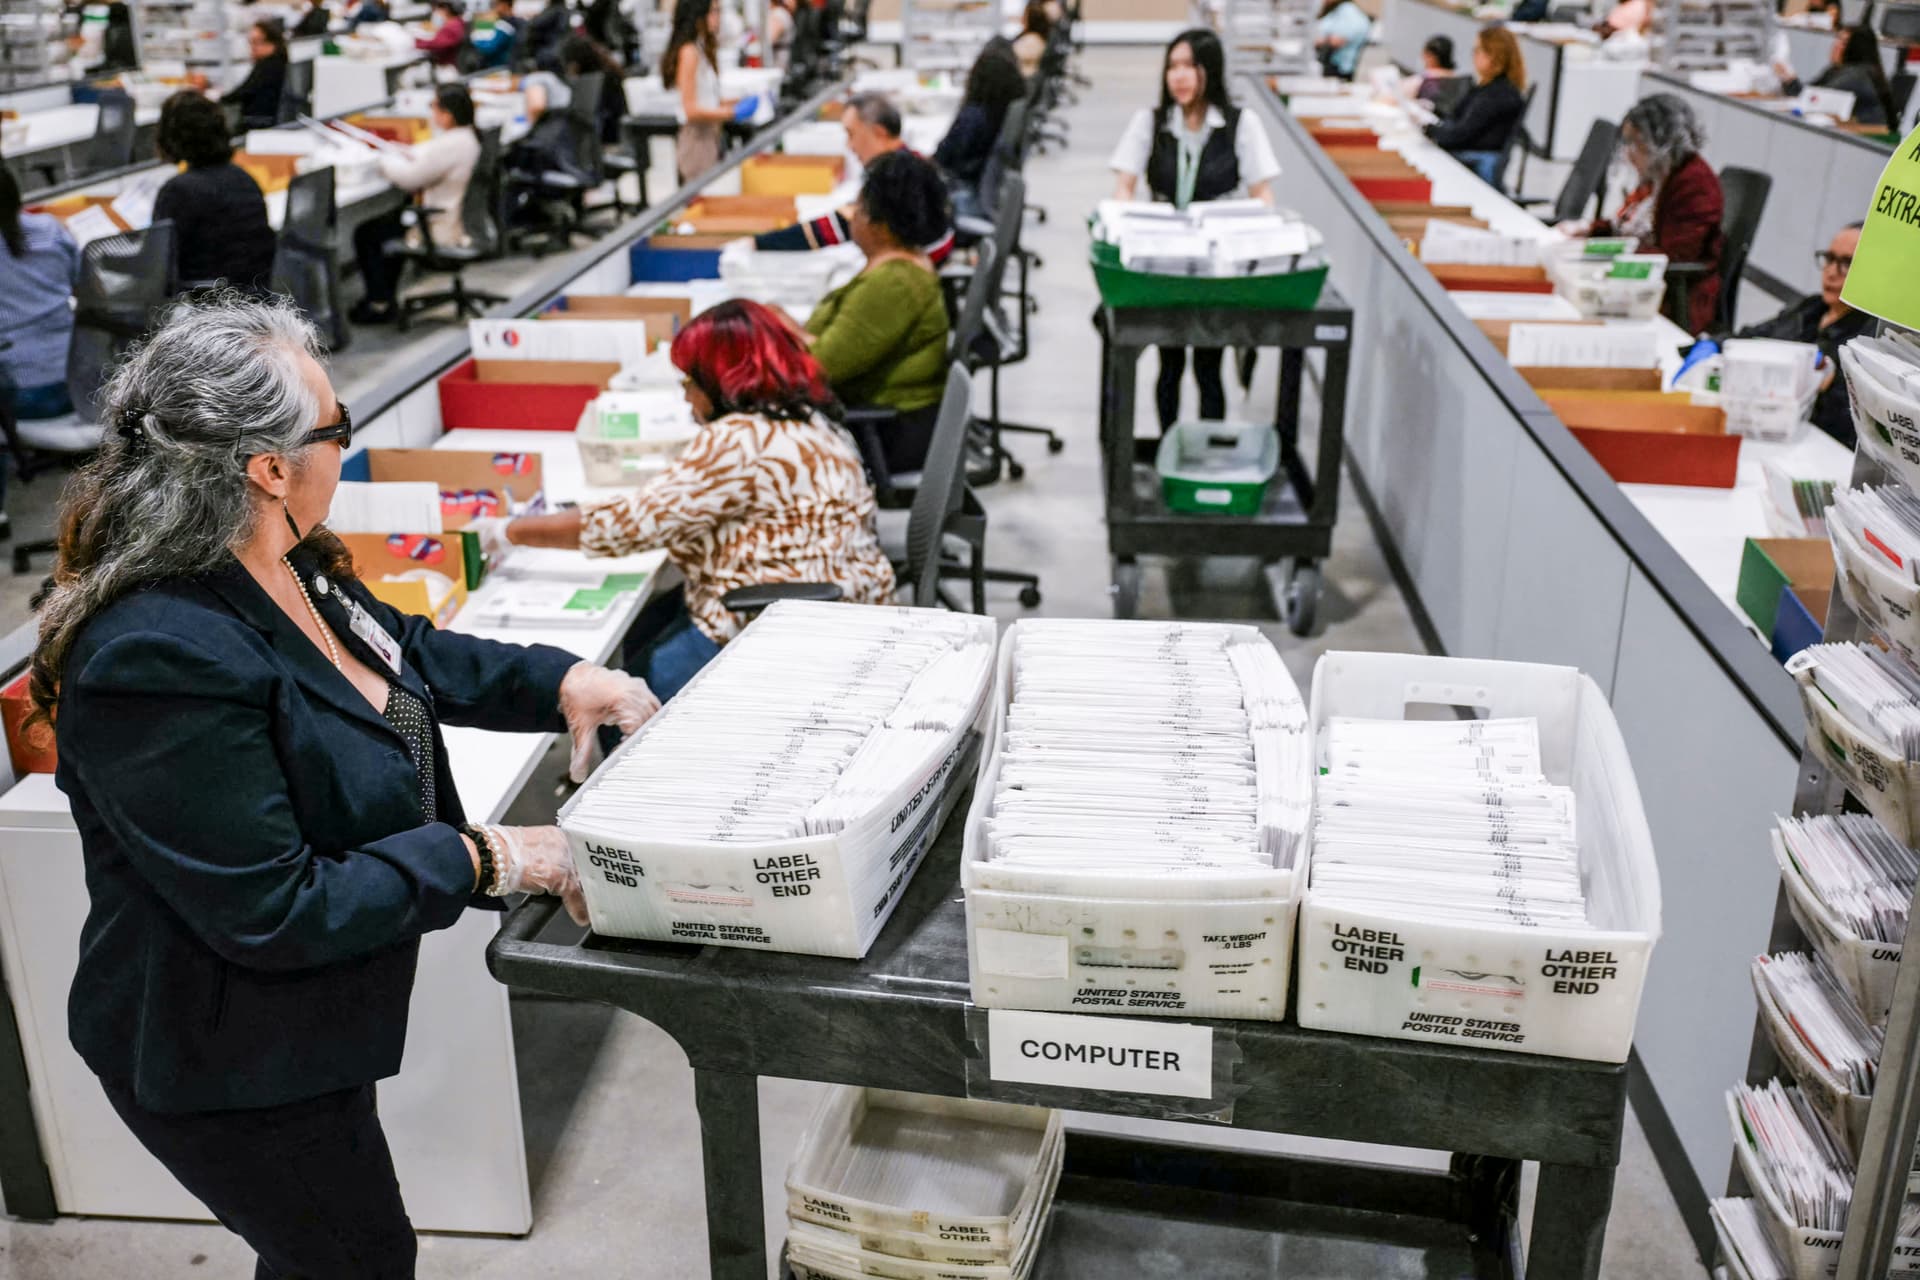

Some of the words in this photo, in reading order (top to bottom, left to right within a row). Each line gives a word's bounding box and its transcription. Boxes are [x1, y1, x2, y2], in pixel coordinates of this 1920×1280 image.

[1887, 409, 1919, 433] LABEL
[585, 841, 641, 863] LABEL
[590, 855, 646, 877] OTHER
[753, 853, 818, 870] LABEL
[604, 870, 638, 888] END
[756, 867, 822, 884] OTHER
[772, 884, 811, 898] END
[672, 921, 716, 931] UNITED
[718, 924, 763, 935] STATES
[672, 929, 718, 939] POSTAL
[720, 933, 771, 944] SERVICE
[1229, 931, 1267, 942] WEIGHT
[1334, 923, 1405, 947] LABEL
[1232, 940, 1252, 949] LBS
[1331, 938, 1405, 962] OTHER
[1545, 948, 1618, 964] LABEL
[1344, 956, 1389, 975] END
[1541, 964, 1617, 980] OTHER
[1077, 988, 1128, 997] UNITED
[1129, 990, 1181, 1000] STATES
[1553, 980, 1600, 995] END
[1071, 997, 1125, 1006] POSTAL
[1127, 999, 1187, 1009] SERVICE
[1409, 1012, 1463, 1026] UNITED
[1464, 1018, 1521, 1032] STATES
[1401, 1021, 1458, 1035] POSTAL
[1461, 1028, 1526, 1043] SERVICE
[1020, 1039, 1181, 1072] COMPUTER
[803, 1195, 849, 1215] LABEL
[804, 1204, 852, 1222] OTHER
[939, 1224, 989, 1234] LABEL
[939, 1232, 992, 1242] OTHER
